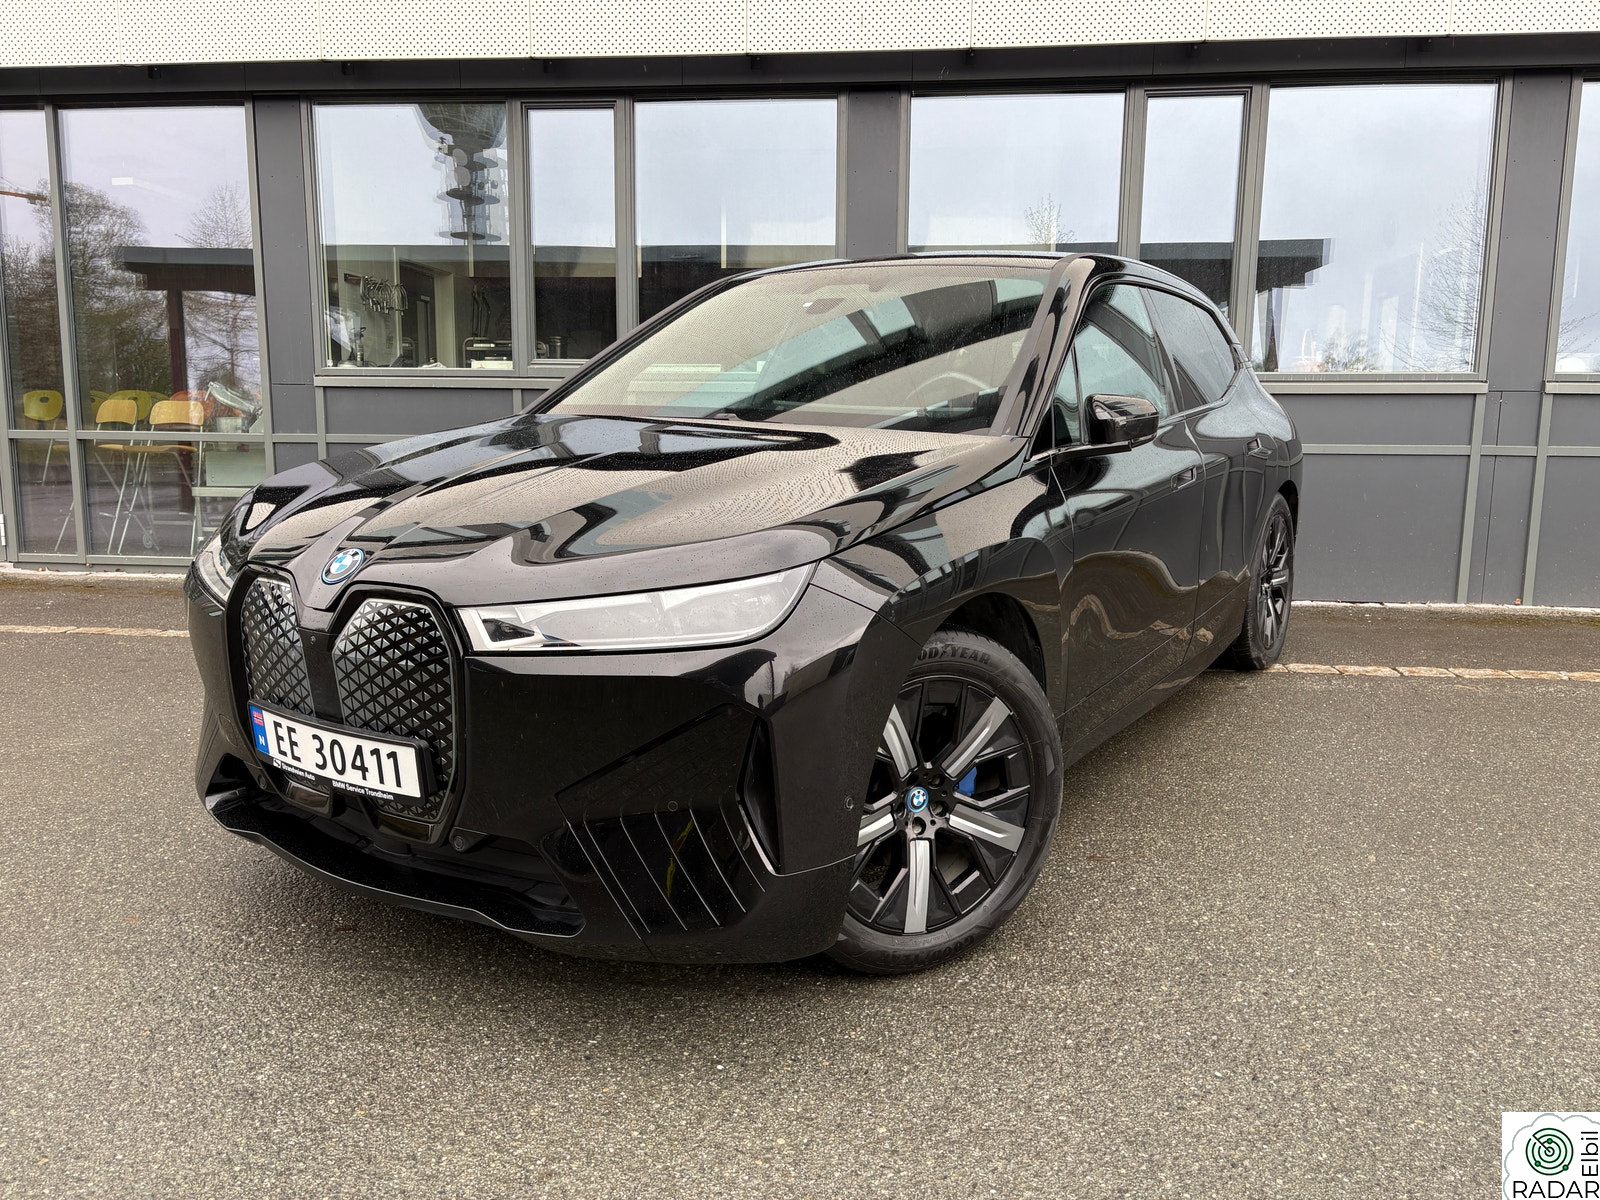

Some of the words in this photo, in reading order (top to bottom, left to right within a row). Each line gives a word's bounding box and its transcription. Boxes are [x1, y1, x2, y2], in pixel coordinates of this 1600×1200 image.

[918, 644, 991, 665] ODYEAR
[258, 734, 266, 746] N
[273, 720, 301, 762] EE
[311, 733, 402, 788] 30411
[331, 779, 346, 790] BMW
[345, 783, 365, 795] Service
[365, 787, 394, 801] Trondheim
